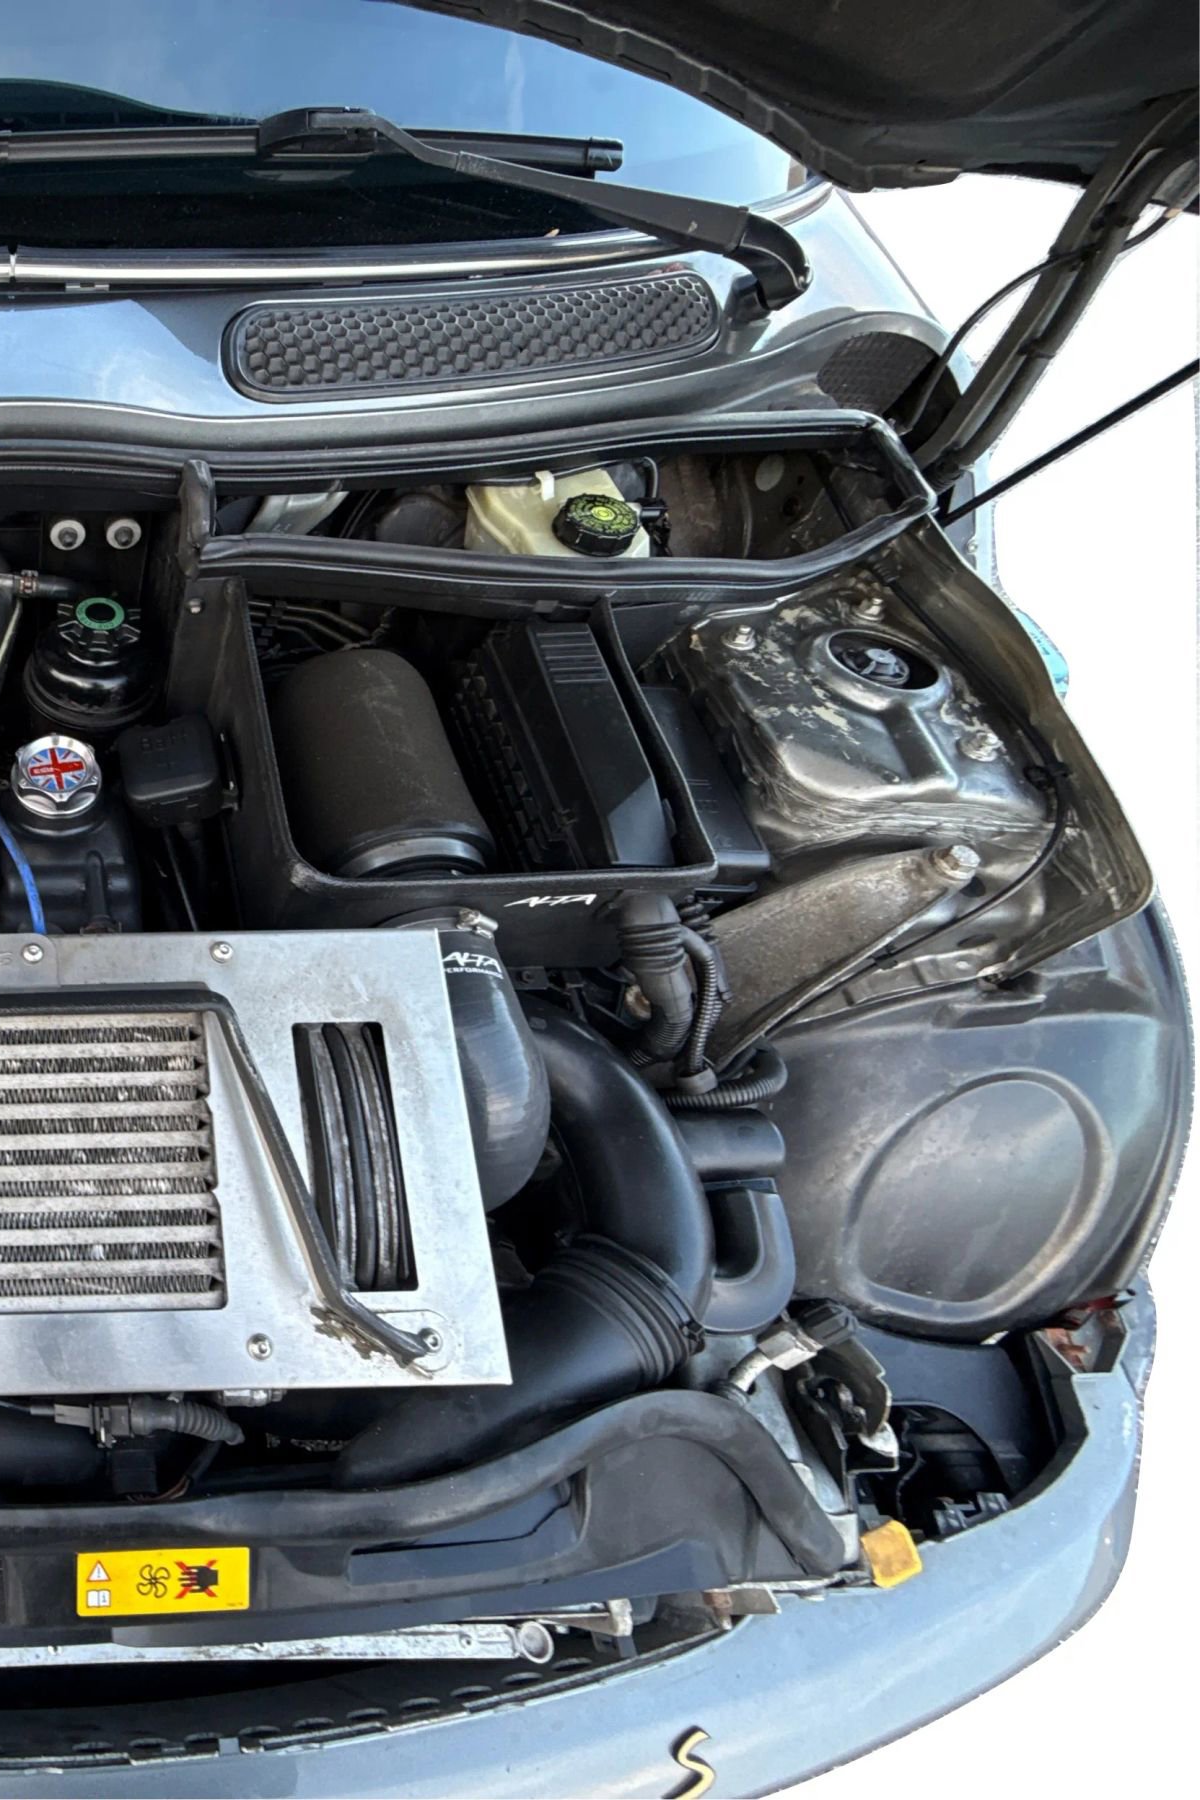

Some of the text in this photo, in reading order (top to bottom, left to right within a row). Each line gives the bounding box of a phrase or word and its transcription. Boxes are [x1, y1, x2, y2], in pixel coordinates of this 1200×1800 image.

[503, 893, 597, 908] ALTA
[442, 951, 502, 973] ALTA
[661, 1725, 716, 1800] S
